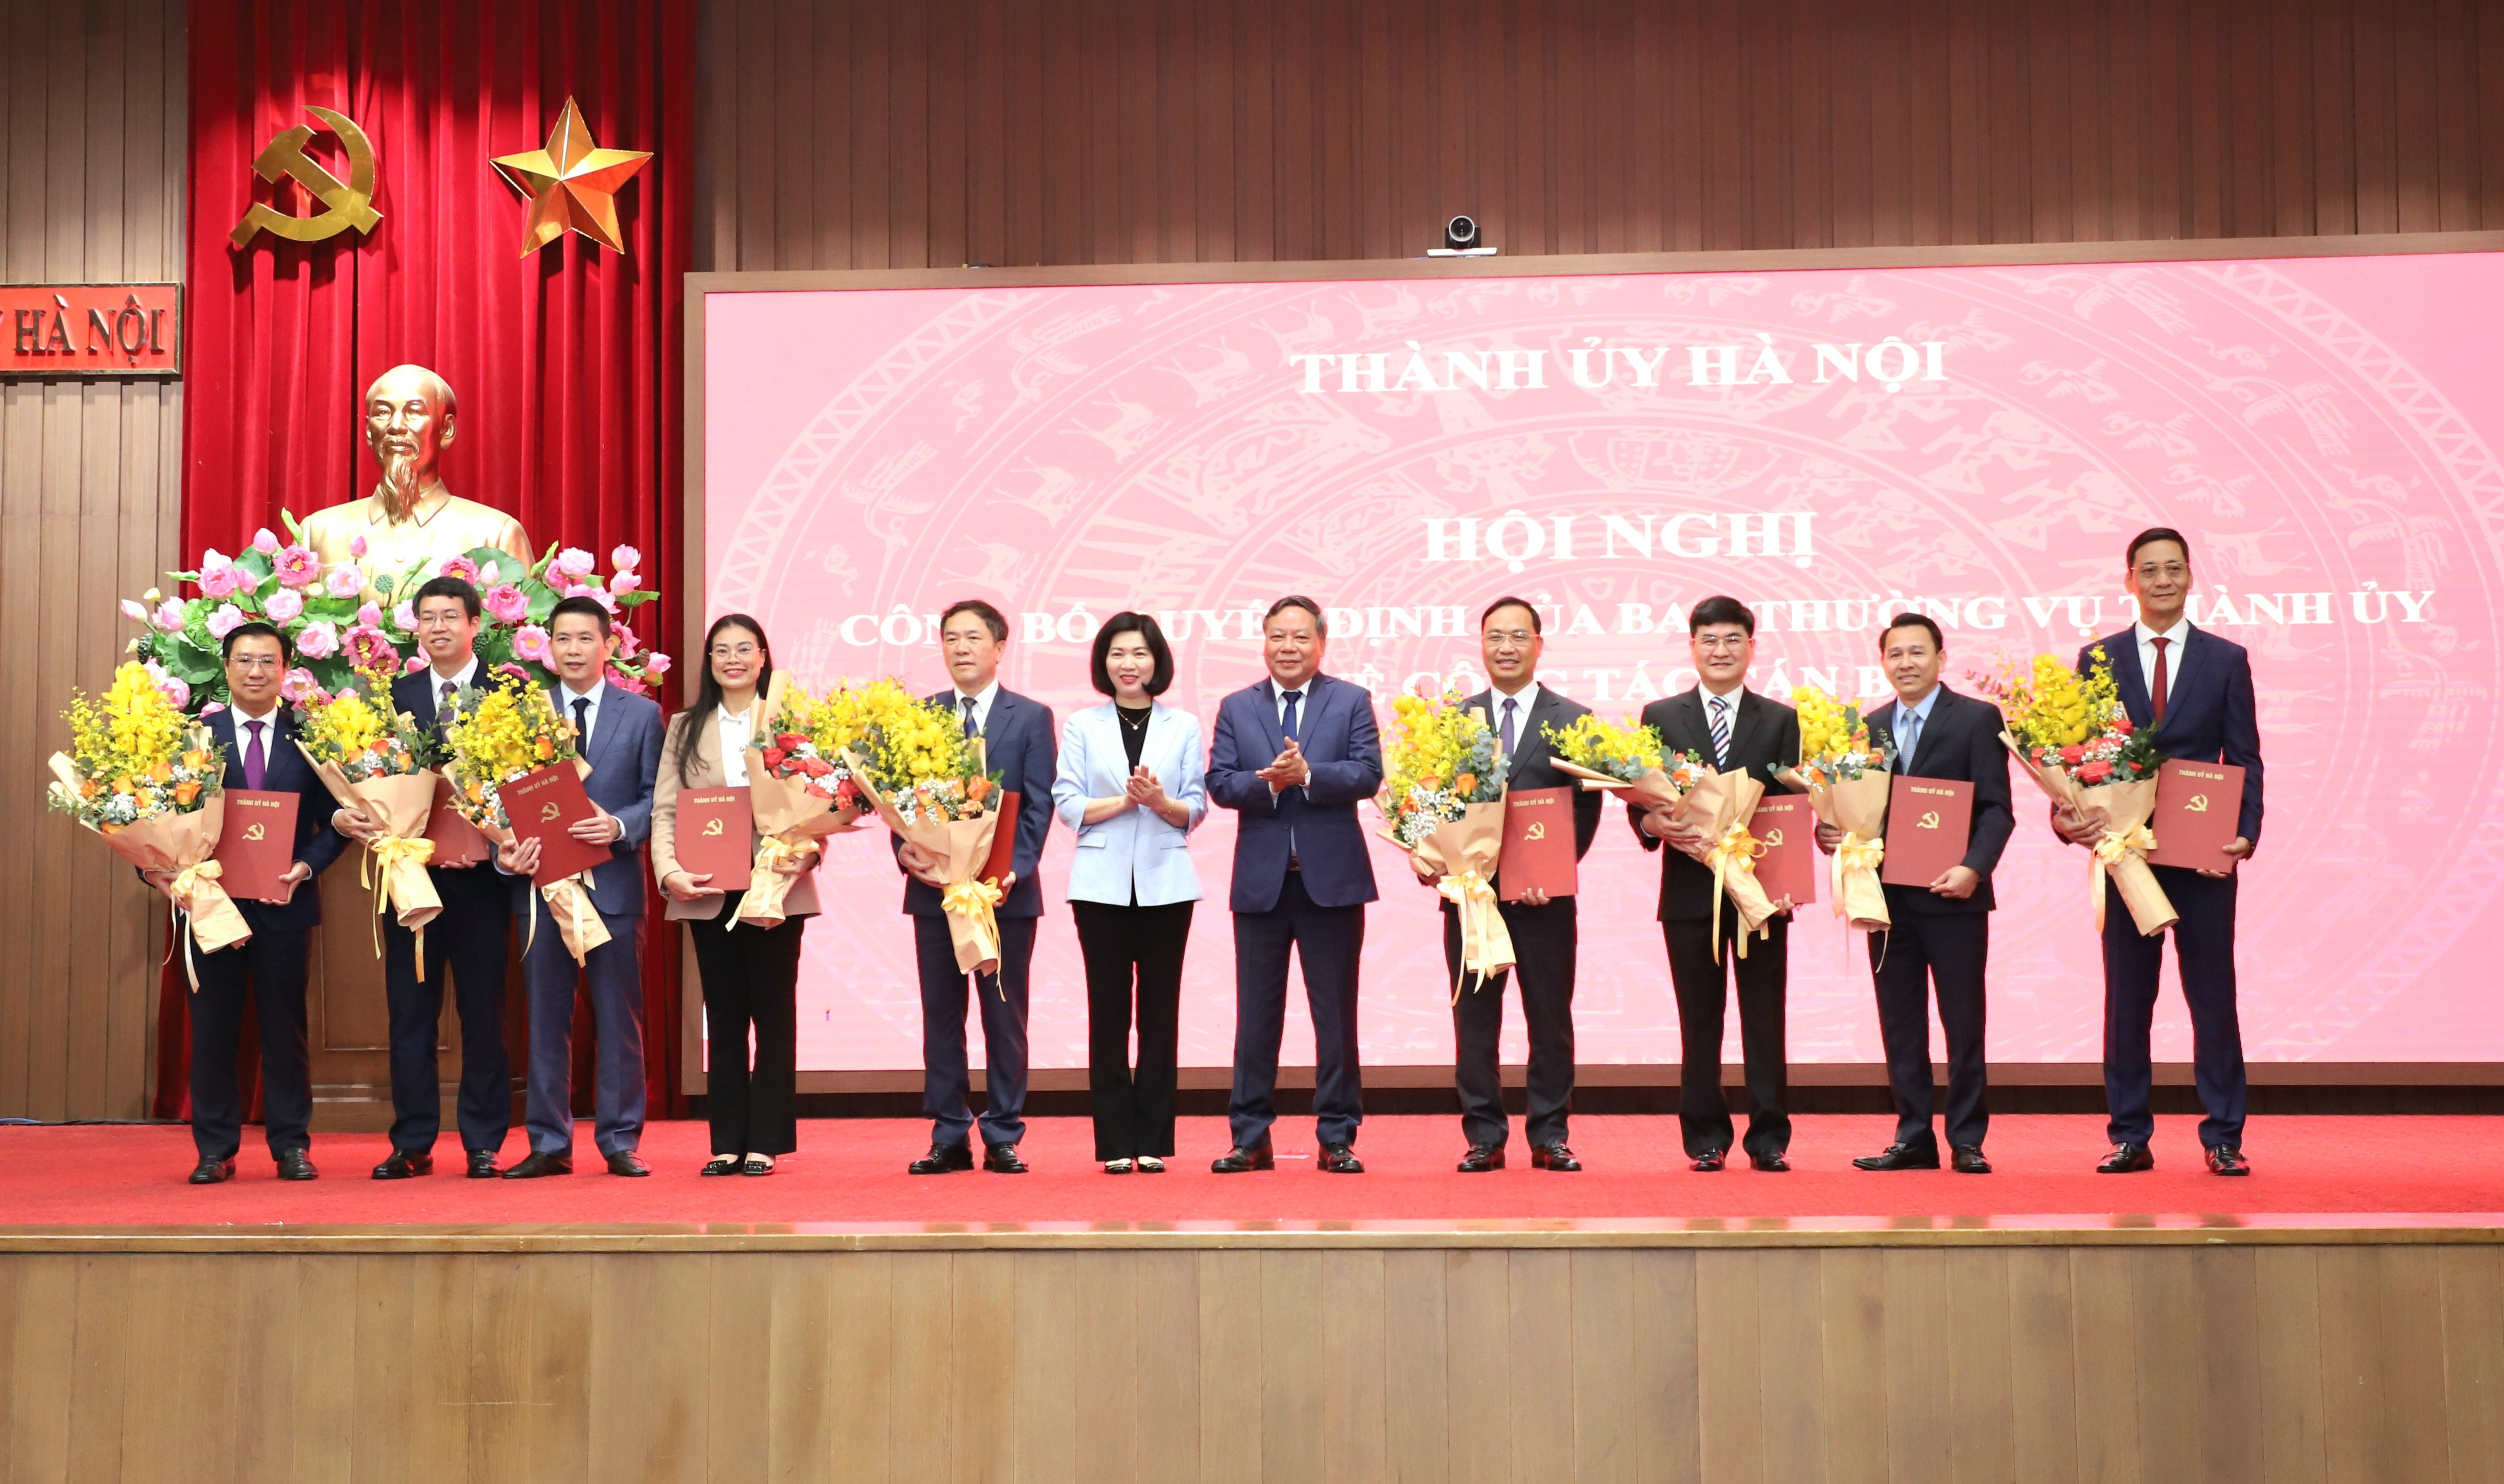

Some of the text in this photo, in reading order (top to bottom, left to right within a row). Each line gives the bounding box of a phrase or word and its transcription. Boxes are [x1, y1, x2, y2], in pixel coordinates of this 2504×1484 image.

[14, 294, 165, 368] HÀ NỘI
[1289, 333, 1948, 393] THÀNH ỦY HÀ NỘI
[1420, 509, 1819, 574] HỘI NGHỊ
[840, 604, 942, 646] CÔ
[1020, 601, 1099, 644] BỐ
[1156, 599, 1267, 642] UYẾ
[1325, 605, 1470, 647] ĐỊNH
[1531, 594, 1606, 636] ỦA
[1617, 602, 1691, 634] BA
[1749, 590, 2008, 632] THƯỜNG
[2021, 596, 2104, 637] VỤ
[2349, 581, 2434, 623] ỦY
[1337, 663, 1386, 704] Ề
[1402, 661, 1571, 701] CÔG
[1583, 659, 1699, 701] TÁC
[1748, 658, 1840, 698] ÁN
